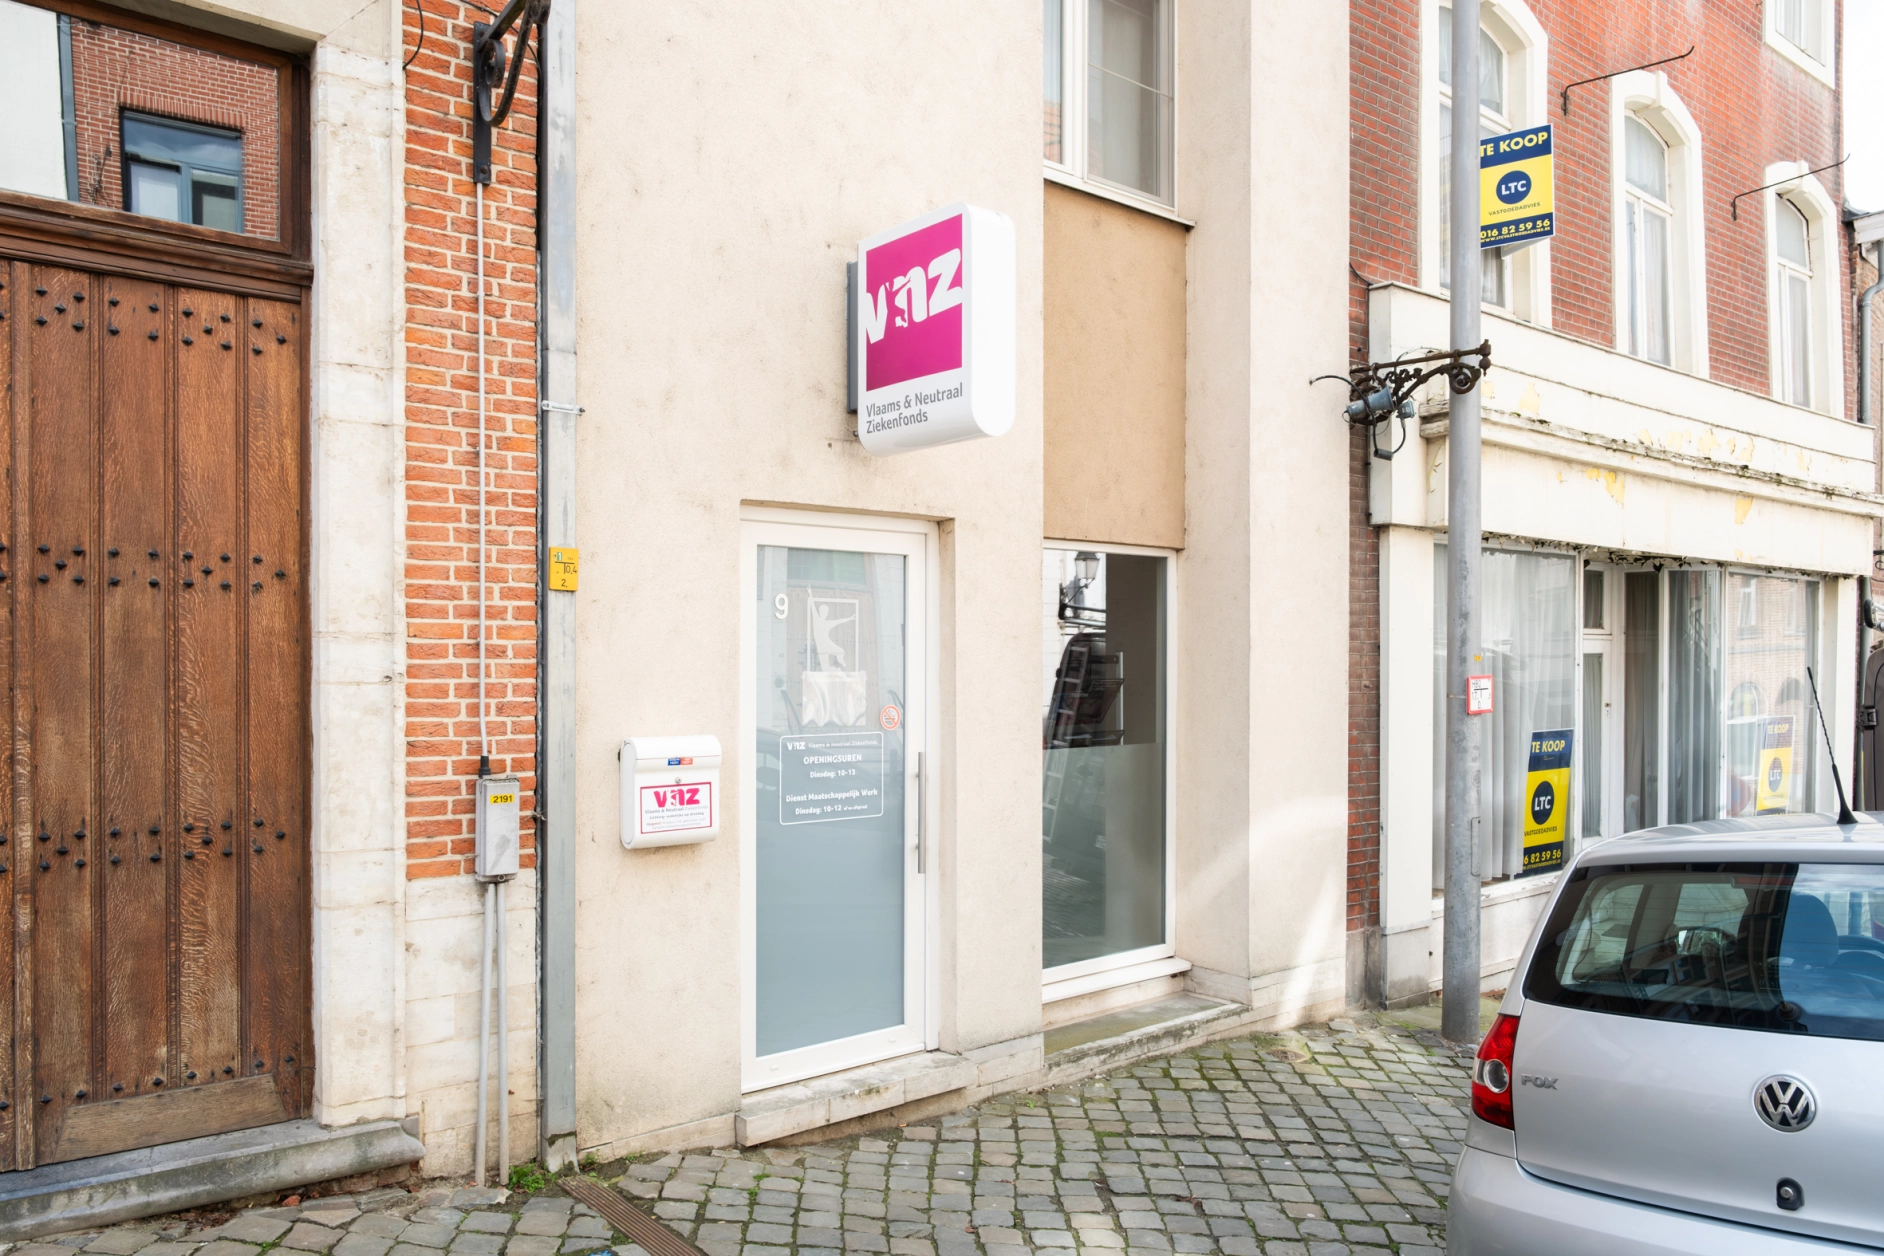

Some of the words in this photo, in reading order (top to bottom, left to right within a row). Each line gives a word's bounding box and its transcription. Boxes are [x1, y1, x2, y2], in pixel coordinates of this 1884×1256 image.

[1480, 143, 1494, 157] TE
[1499, 131, 1548, 153] KOOP
[1501, 180, 1527, 195] LTC
[1488, 202, 1541, 216] VASTGOEDADVIES
[1480, 228, 1499, 239] 016
[1501, 225, 1516, 235] 82
[1518, 221, 1533, 231] 59
[1536, 218, 1550, 228] 56
[866, 399, 901, 418] Vlaams
[903, 394, 912, 409] &
[915, 382, 963, 407] Neutraal
[866, 409, 929, 434] Ziekenfonds
[774, 593, 789, 620] 9
[1767, 725, 1773, 734] TE
[1774, 724, 1789, 734] KOOP
[1531, 741, 1541, 753] TE
[1541, 739, 1566, 753] KOOP
[803, 753, 862, 765] OPENINGSUREN
[810, 771, 836, 779] Dinsdag:
[837, 769, 856, 777] 10-13
[493, 795, 513, 804] 2191
[785, 794, 807, 802] Dienst
[808, 790, 860, 801] Maatschappelijk
[861, 788, 878, 796] Werk
[795, 806, 822, 815] Dinsdag:
[823, 805, 842, 813] 10-12
[1534, 795, 1552, 811] LTC
[1530, 853, 1540, 864] 82
[1541, 850, 1551, 862] 59
[1552, 849, 1562, 860] 56
[1521, 1073, 1559, 1091] FOX
